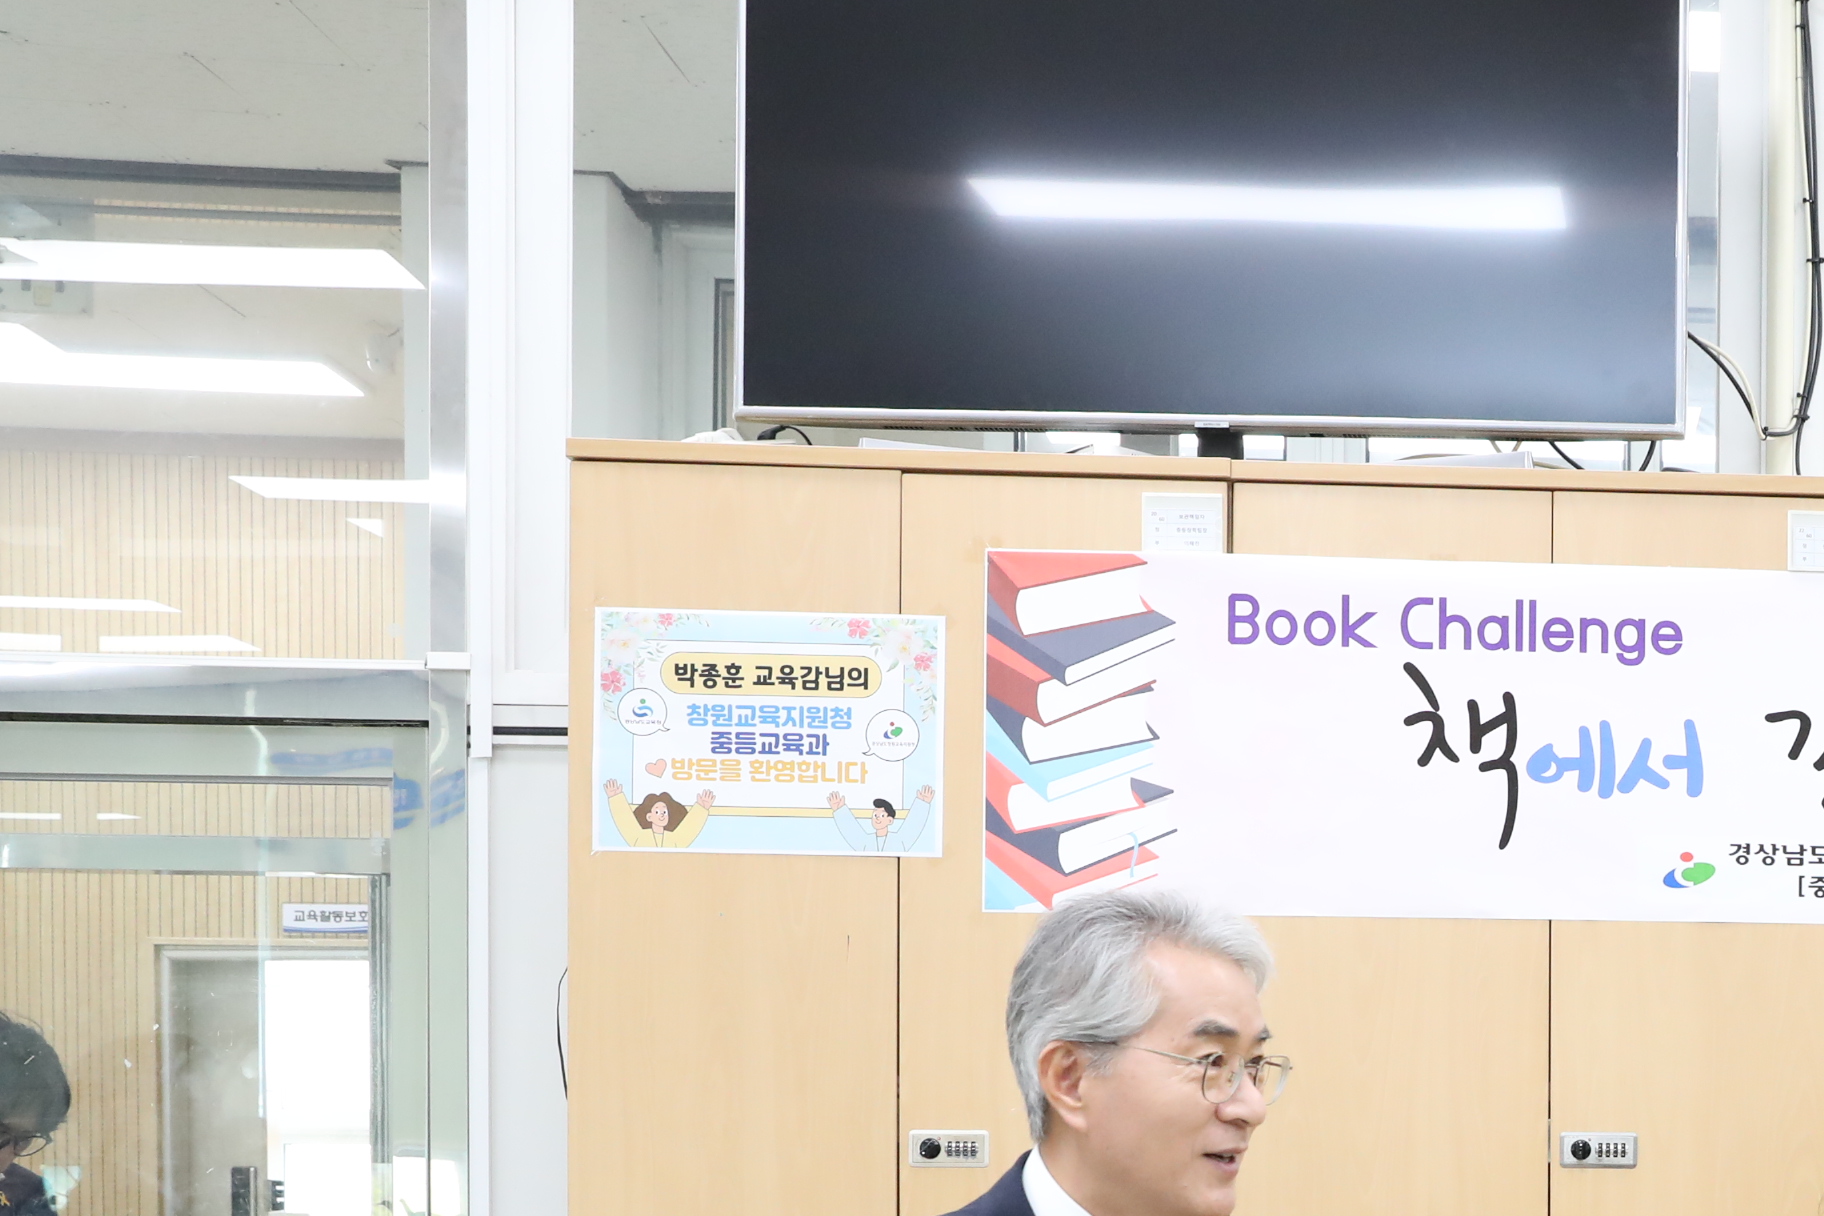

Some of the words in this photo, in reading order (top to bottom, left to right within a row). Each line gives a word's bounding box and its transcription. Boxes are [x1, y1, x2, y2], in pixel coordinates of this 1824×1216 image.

[1228, 593, 1378, 648] Book
[1400, 597, 1683, 666] Challenge
[674, 662, 745, 689] 박종훈
[752, 665, 869, 692] 교육감님의
[686, 703, 852, 730] 창원교육지원청
[710, 731, 830, 757] 중등교육과
[1403, 662, 1704, 849] 책에서
[671, 758, 741, 782] 방문을
[749, 759, 868, 784] 환영합니다
